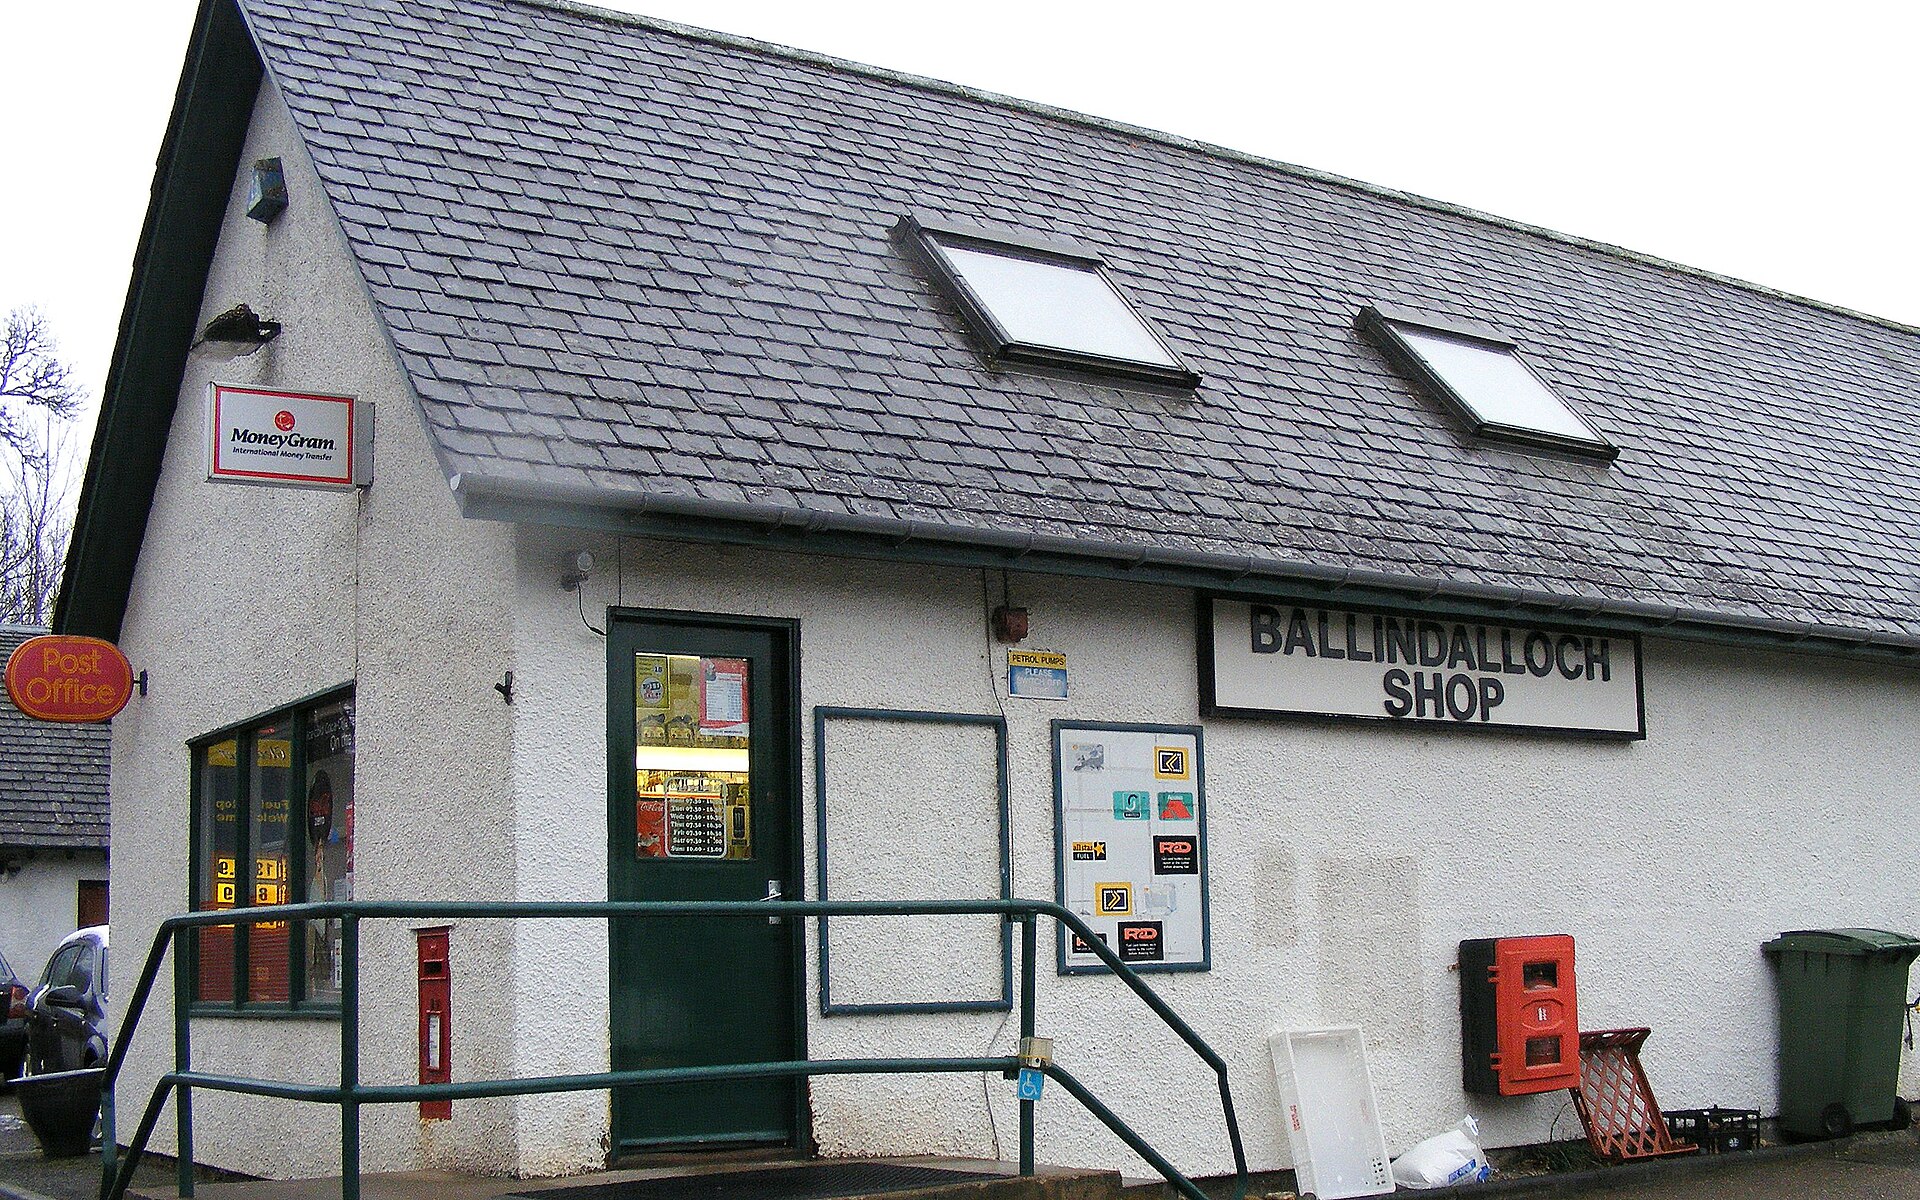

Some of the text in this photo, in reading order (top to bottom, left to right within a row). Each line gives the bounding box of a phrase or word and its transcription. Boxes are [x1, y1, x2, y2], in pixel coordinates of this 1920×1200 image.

[231, 428, 335, 450] MoneyGram
[232, 446, 332, 461] International Money Transfer
[1250, 603, 1611, 682] BALLINDALLOCH
[43, 647, 102, 675] Post
[1012, 654, 1065, 665] PETROL PUMPS
[1025, 667, 1053, 676] PLEASE
[26, 676, 116, 705] Office
[1383, 668, 1505, 721] SHOP
